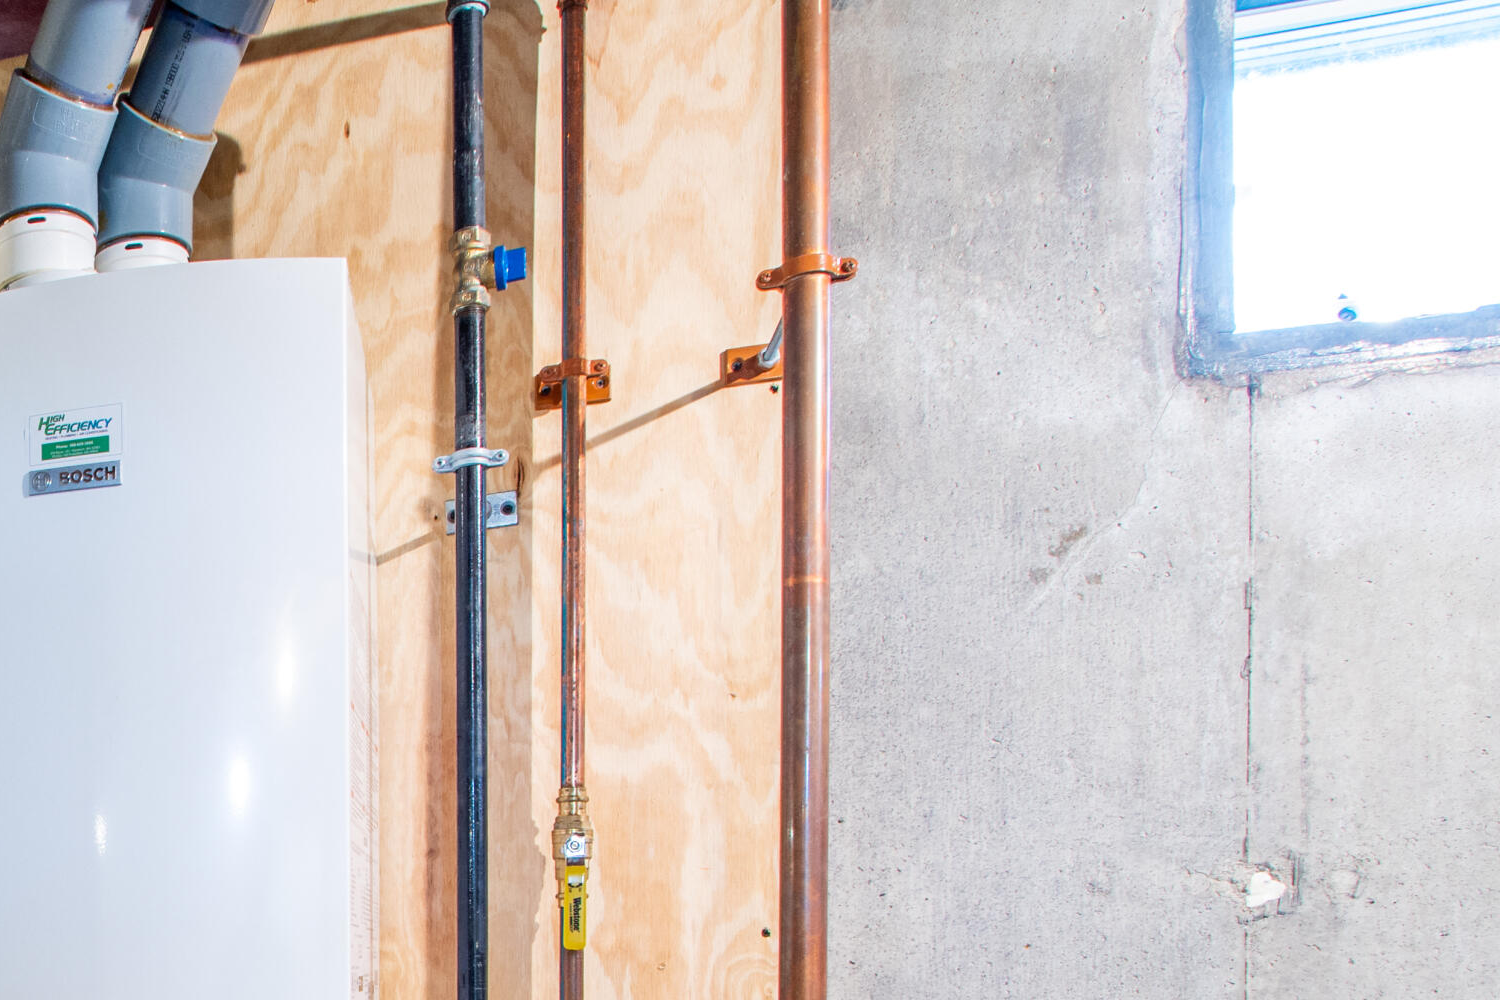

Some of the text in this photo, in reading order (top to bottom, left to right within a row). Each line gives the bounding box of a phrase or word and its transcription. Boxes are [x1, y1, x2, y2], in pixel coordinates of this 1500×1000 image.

[38, 413, 66, 431] HIGH
[44, 417, 112, 436] EFFICIENCY
[59, 466, 116, 485] BOSCH
[573, 897, 582, 933] Webstone
